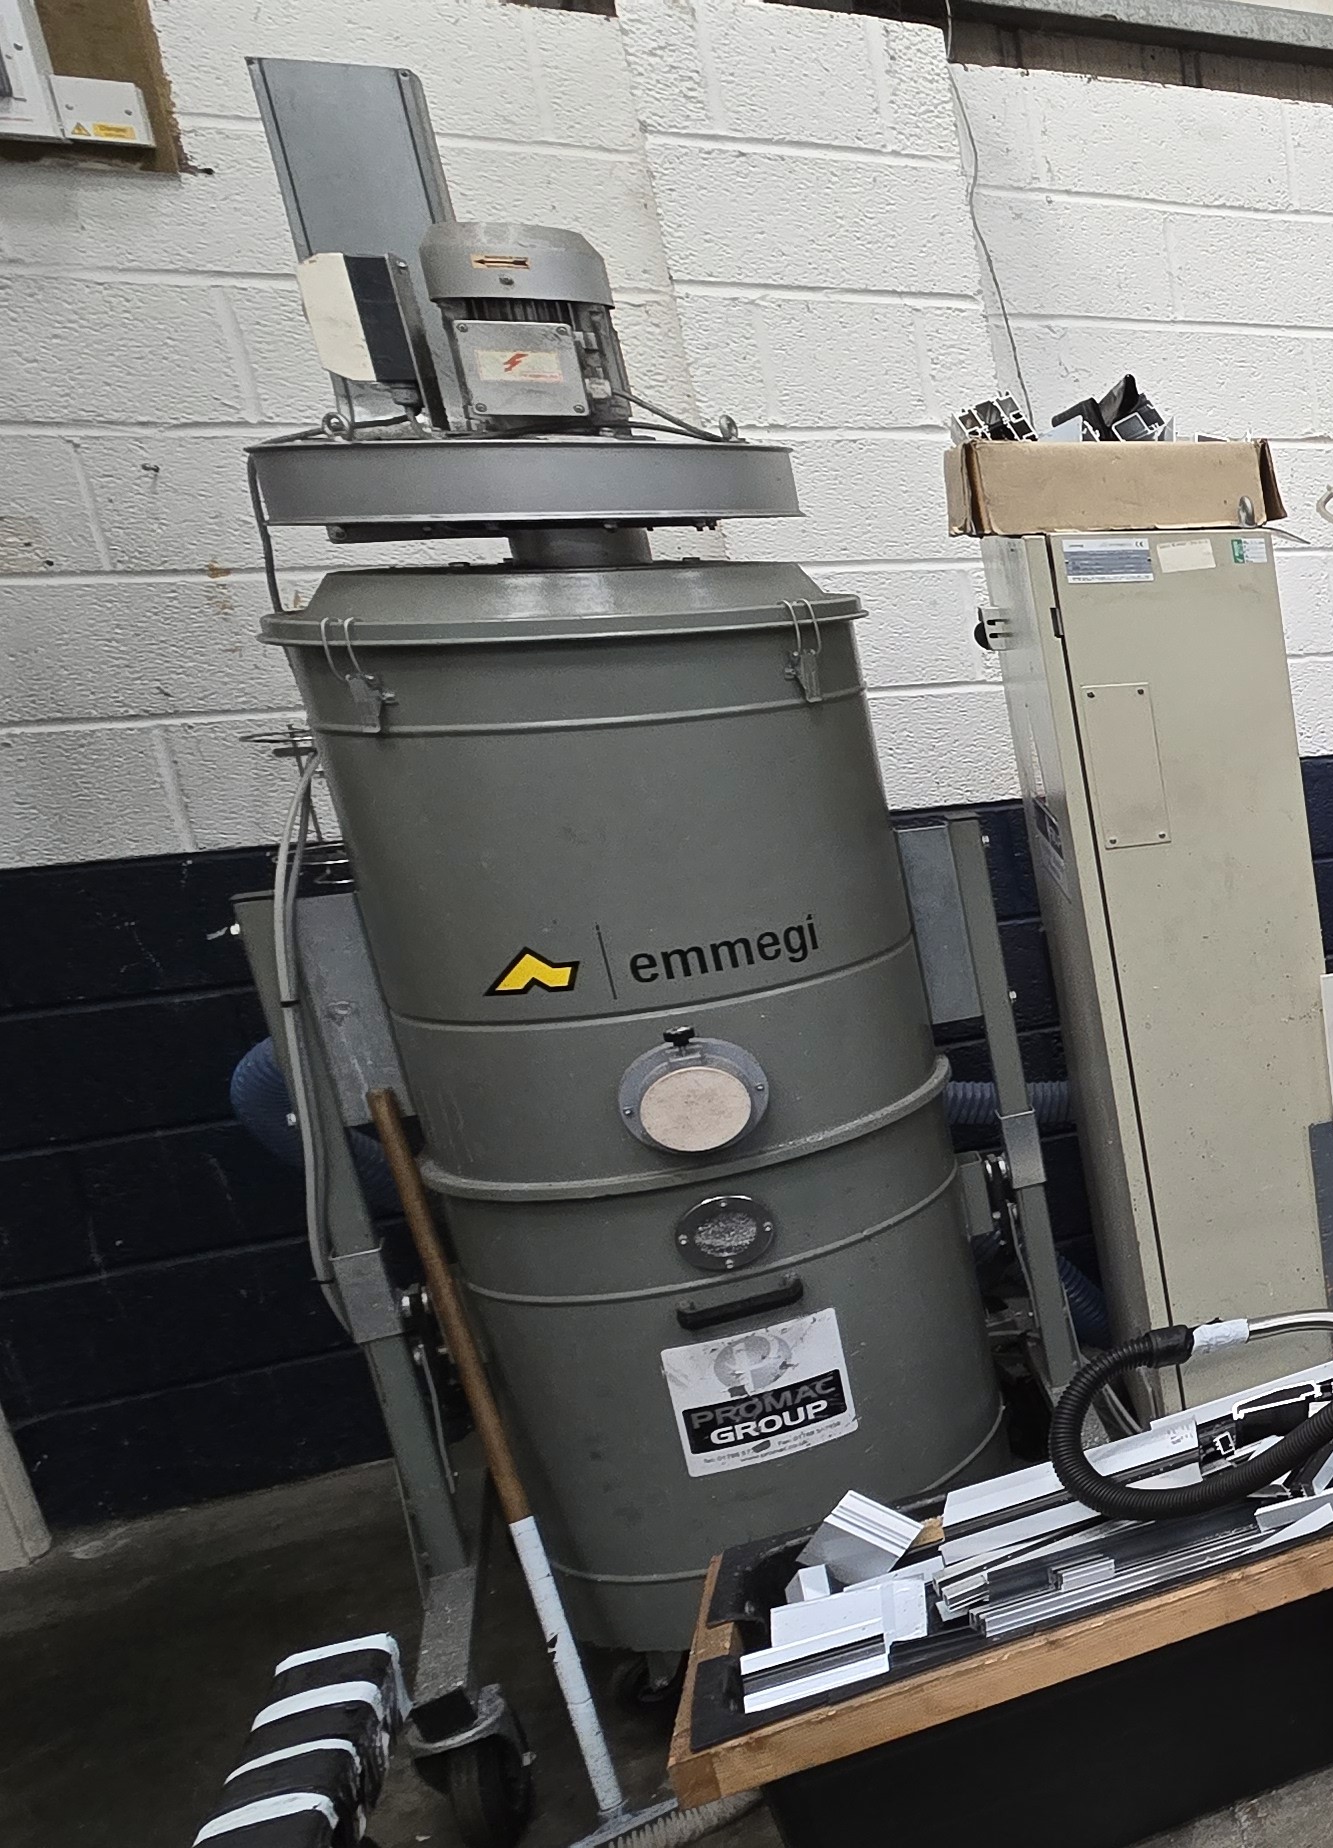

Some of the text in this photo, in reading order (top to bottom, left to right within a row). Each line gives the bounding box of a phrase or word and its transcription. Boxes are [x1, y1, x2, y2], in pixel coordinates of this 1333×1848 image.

[629, 913, 819, 983] emmegi
[690, 1374, 836, 1430] PROMAC
[710, 1400, 828, 1445] GROUP
